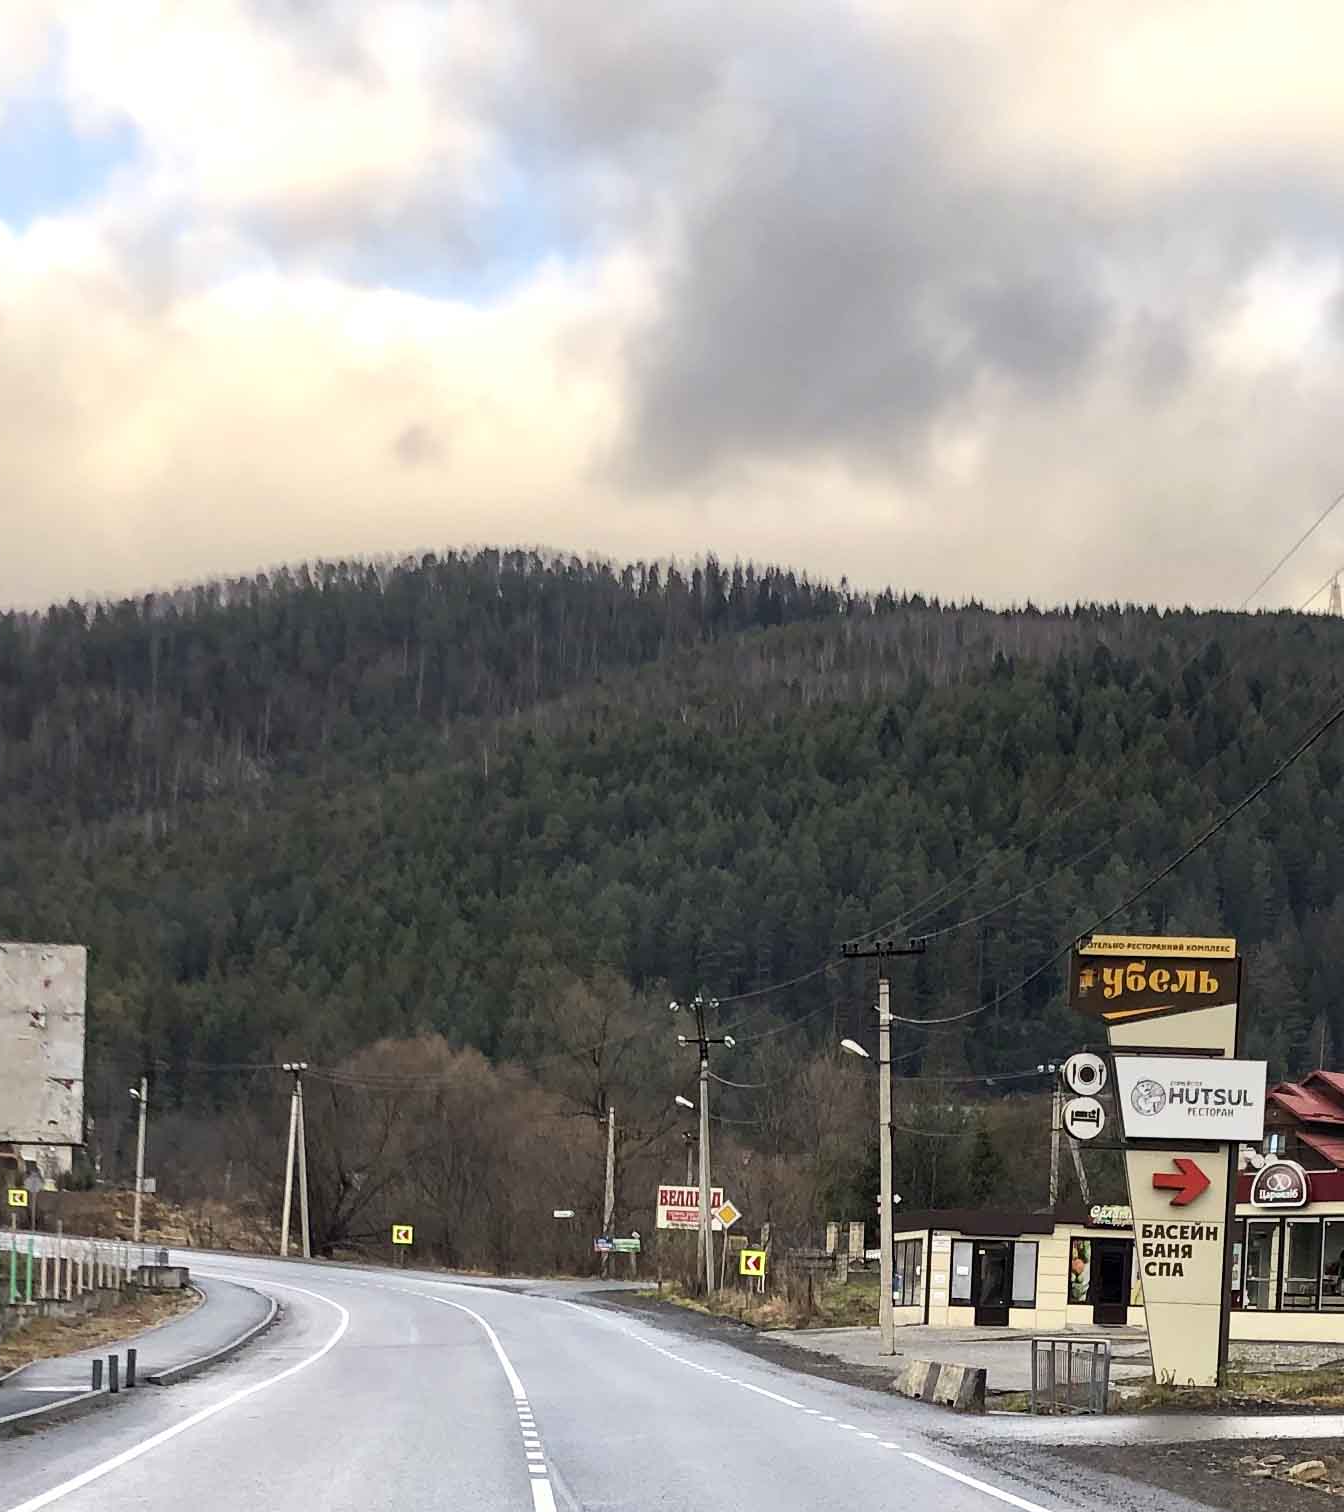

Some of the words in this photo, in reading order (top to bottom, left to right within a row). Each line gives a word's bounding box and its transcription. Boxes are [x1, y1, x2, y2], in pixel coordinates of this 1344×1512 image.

[1083, 941, 1184, 951] ОТЕЛЬНО-РЕСТОРАННИЙ
[1186, 944, 1231, 953] КОМПЛЕКС
[1168, 1087, 1254, 1107] HUTSUL
[1187, 1107, 1234, 1118] РЕСТОРАН
[1141, 1221, 1219, 1241] БАСЕЙН
[1142, 1243, 1193, 1259] БАНЯ
[1144, 1261, 1184, 1277] СПА
